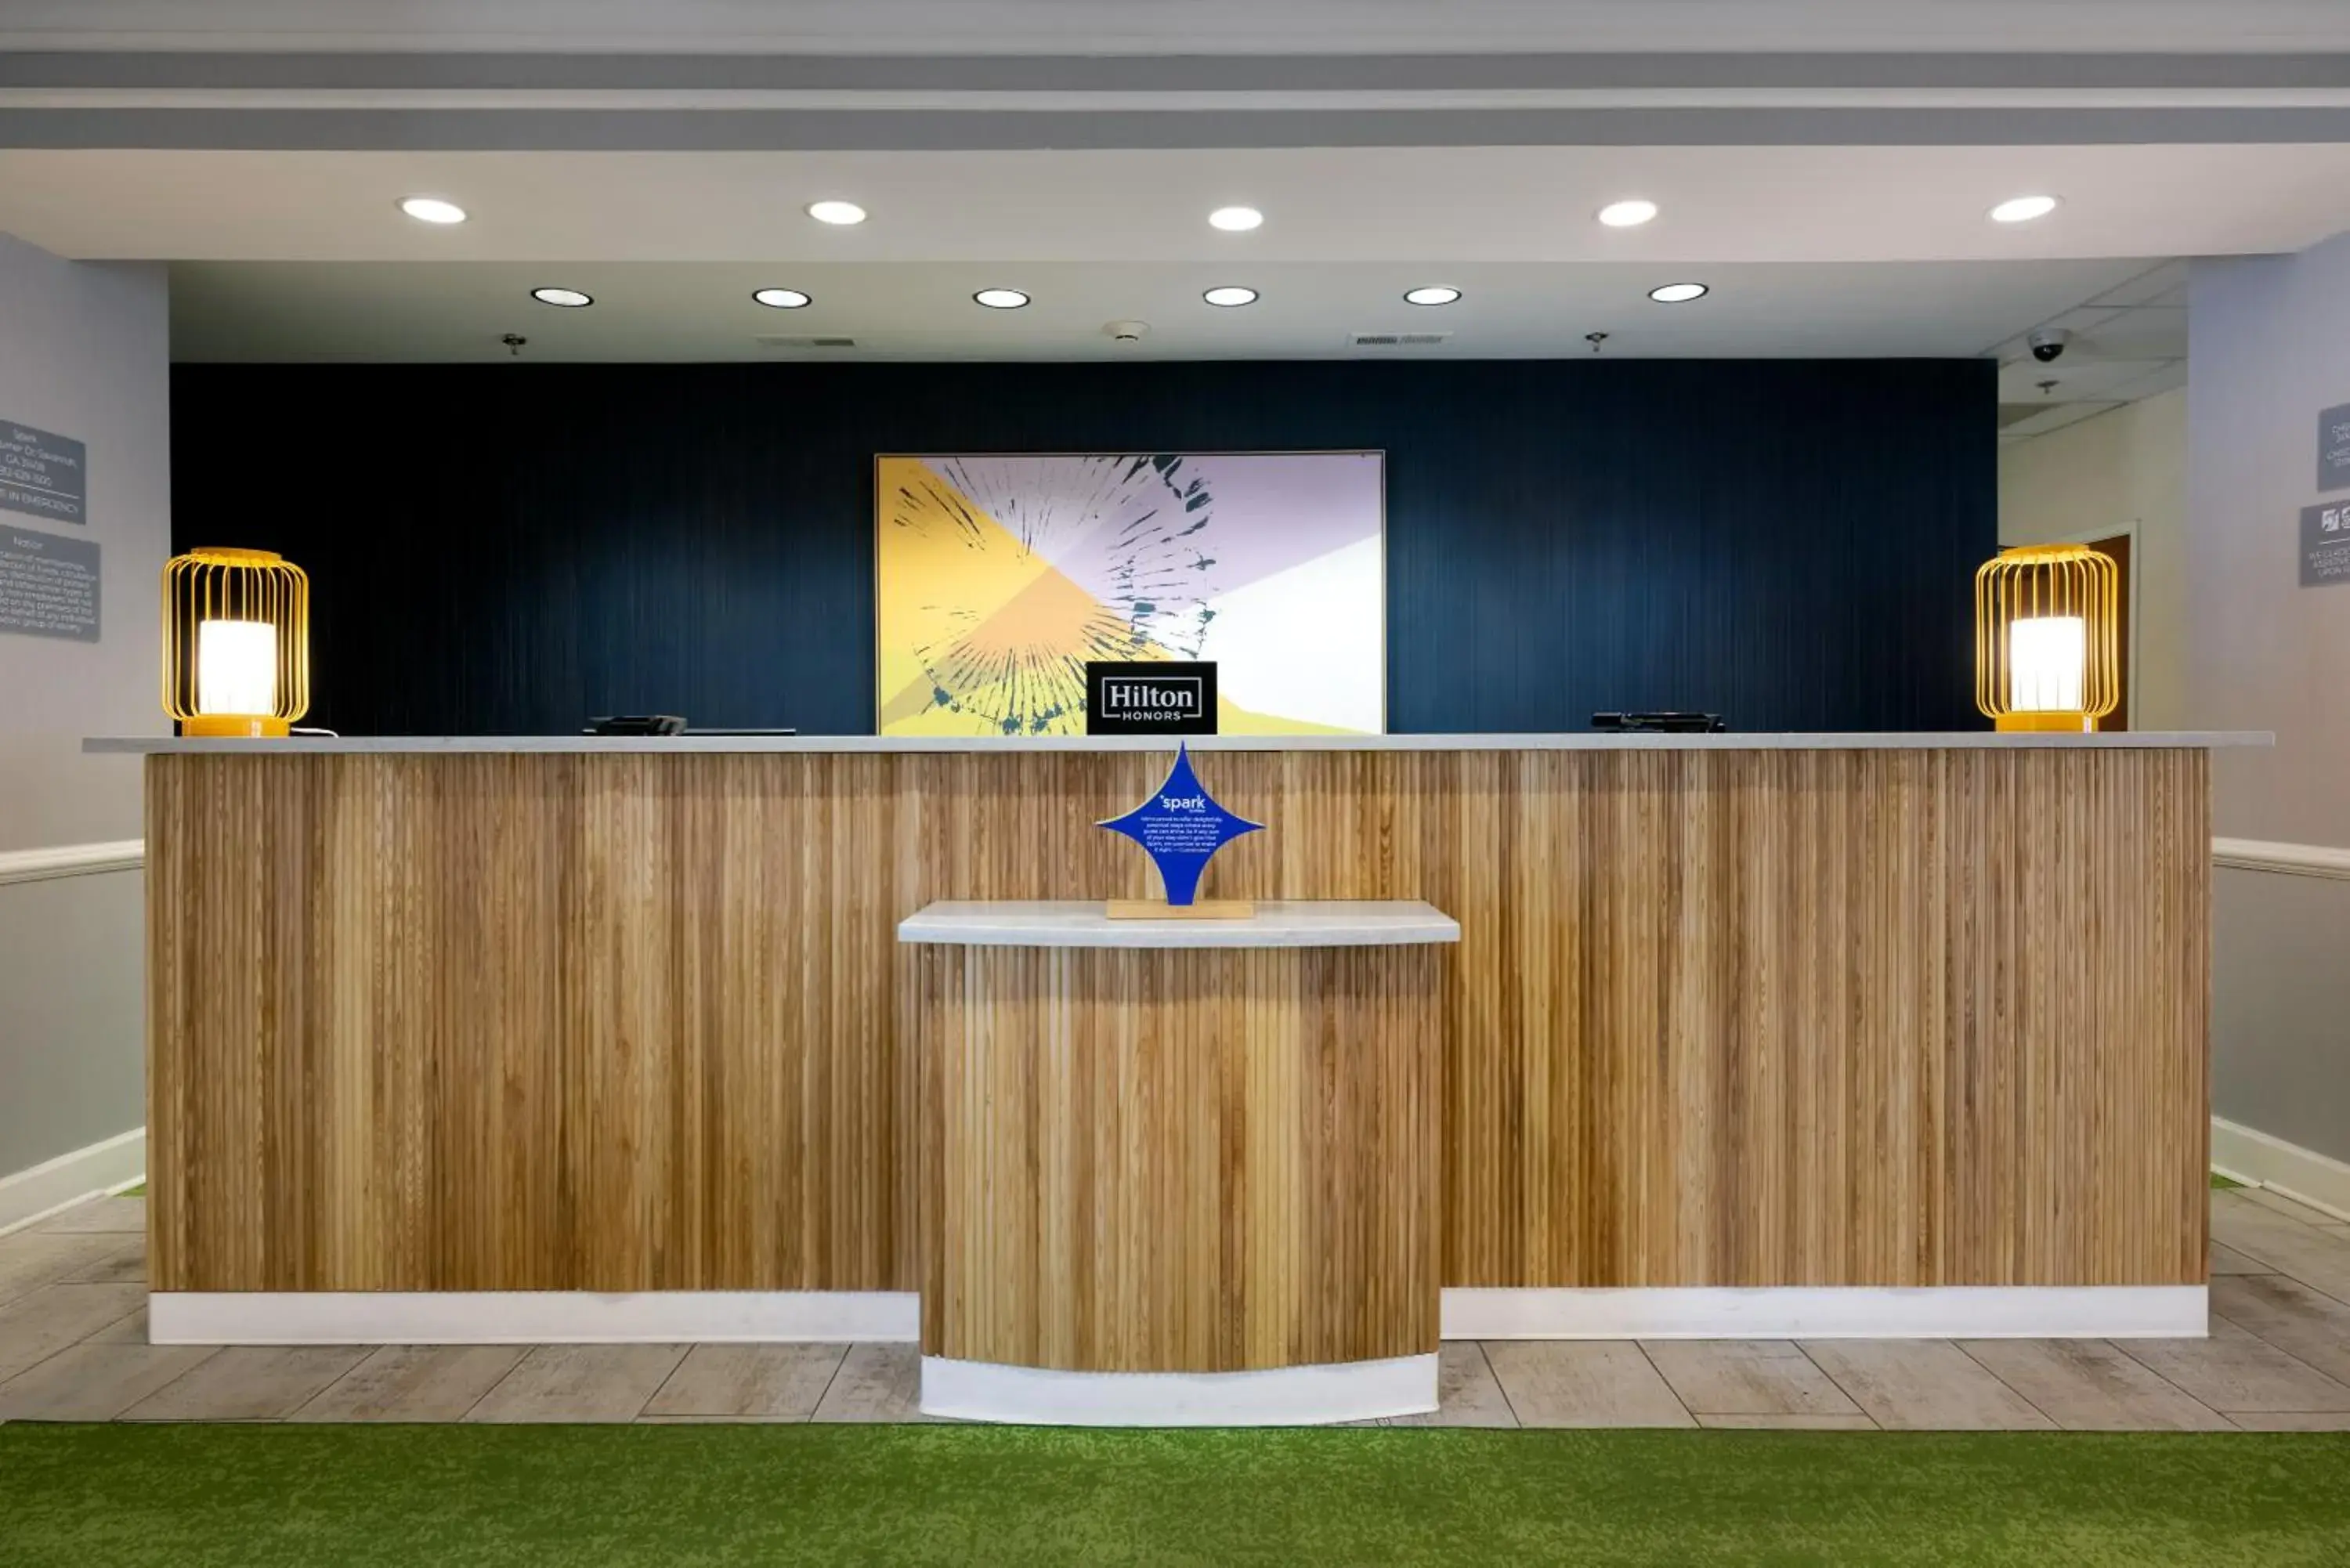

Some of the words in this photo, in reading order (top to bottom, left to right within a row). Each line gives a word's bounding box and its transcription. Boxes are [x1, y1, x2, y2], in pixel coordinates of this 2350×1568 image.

[21, 493, 78, 515] EMERGENCY
[1110, 685, 1194, 707] Hilton
[1123, 710, 1181, 721] HONORS
[1162, 793, 1206, 813] spark
